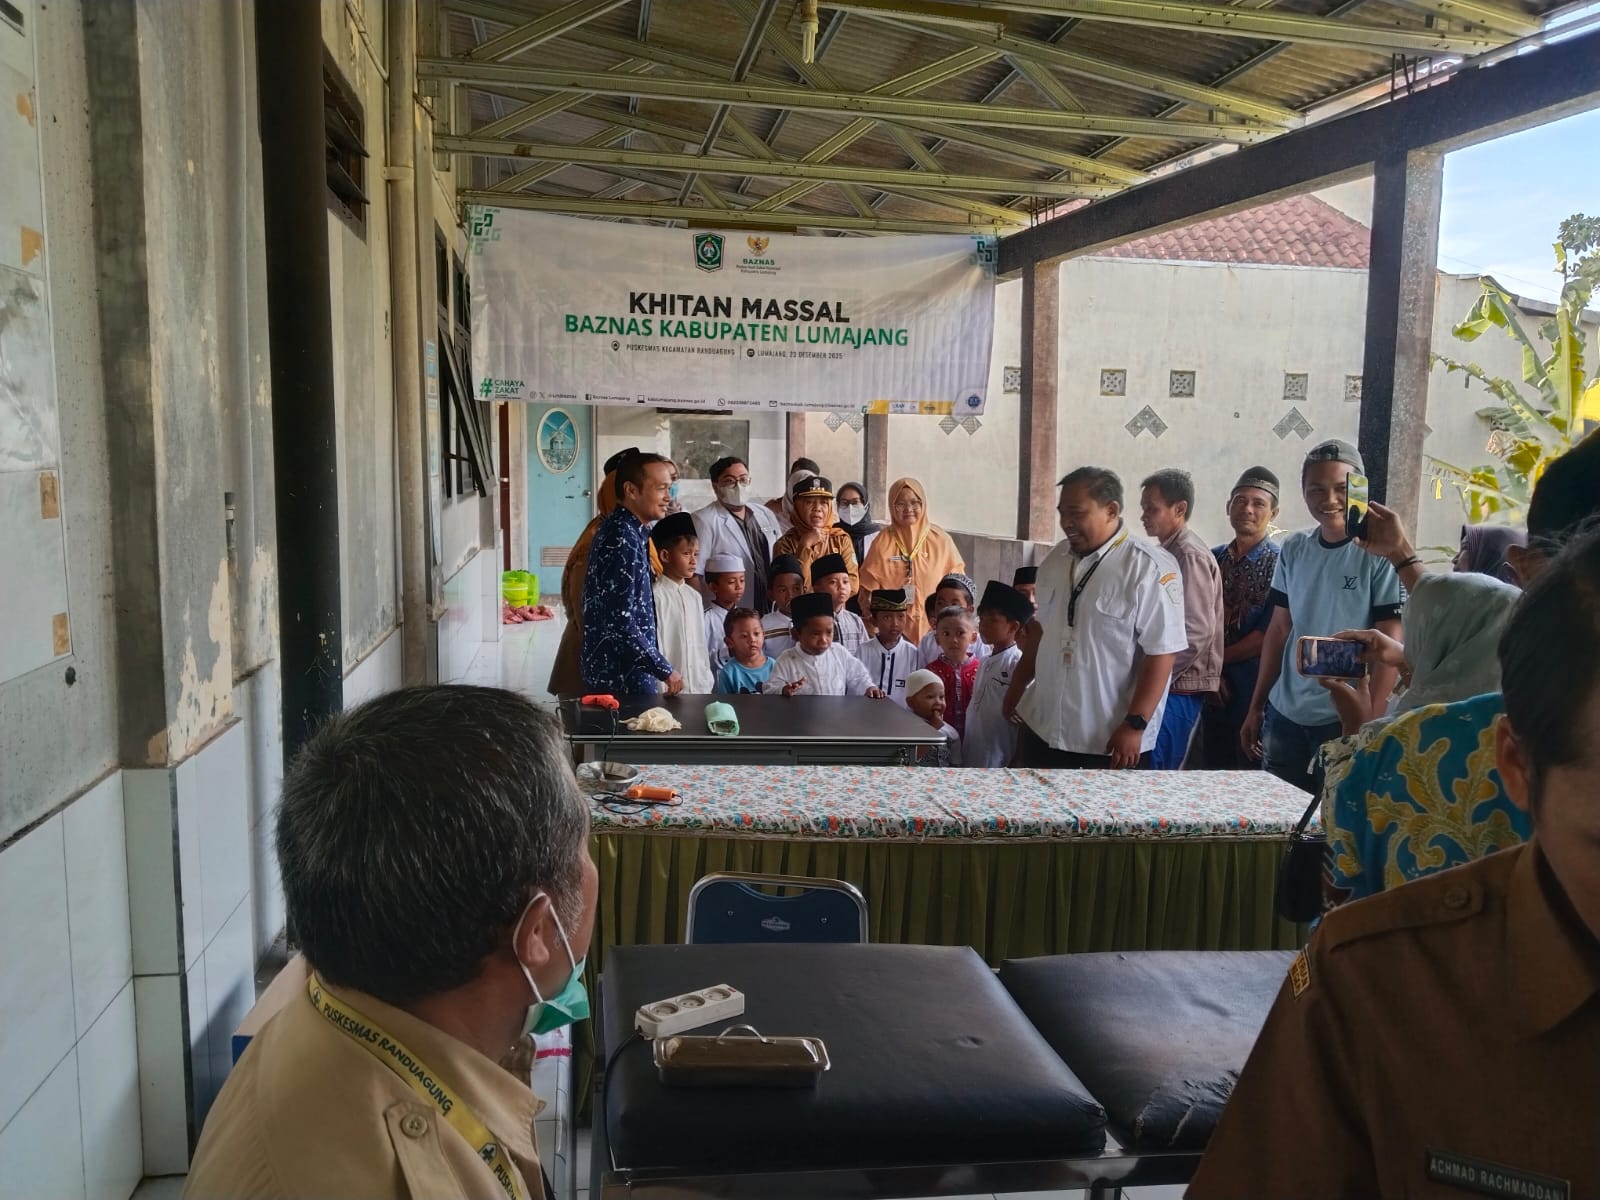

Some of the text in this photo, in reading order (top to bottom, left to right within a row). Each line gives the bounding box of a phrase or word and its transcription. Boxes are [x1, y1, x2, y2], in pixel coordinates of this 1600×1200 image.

[743, 258, 775, 266] BAZNAS
[629, 291, 850, 323] KHITAN MASSAL
[565, 314, 909, 350] BAZNAS KABUPATEN LUMAJANG
[626, 343, 660, 352] PUSKESMAS
[661, 345, 695, 353] KECAMATAN
[798, 351, 827, 359] DESEMBER
[494, 379, 525, 387] CAHAYA
[494, 387, 520, 395] ZAKAT
[323, 1003, 454, 1118] PUSKESMAS RANDUAGUNG
[1430, 1157, 1475, 1182] ACHMAD
